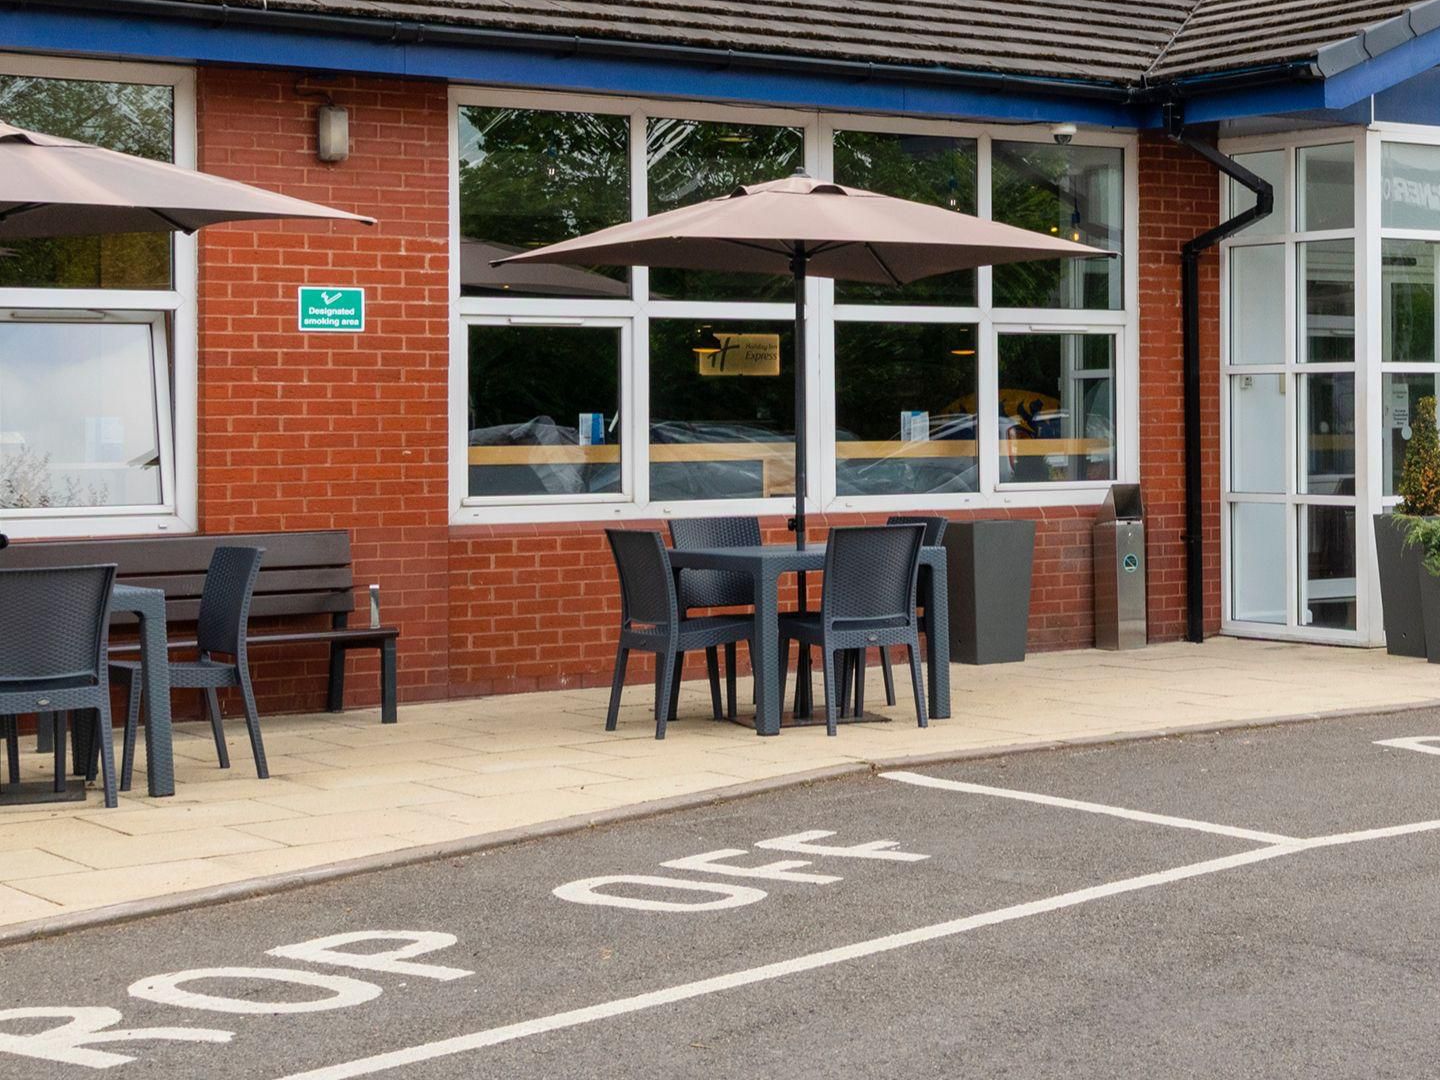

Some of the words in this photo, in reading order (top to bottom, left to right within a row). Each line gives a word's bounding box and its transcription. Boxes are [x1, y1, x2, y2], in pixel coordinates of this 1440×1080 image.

[308, 306, 355, 317] Designated
[304, 317, 340, 327] smoking
[341, 318, 360, 326] area
[745, 350, 778, 361] Express
[553, 829, 932, 913] OFF
